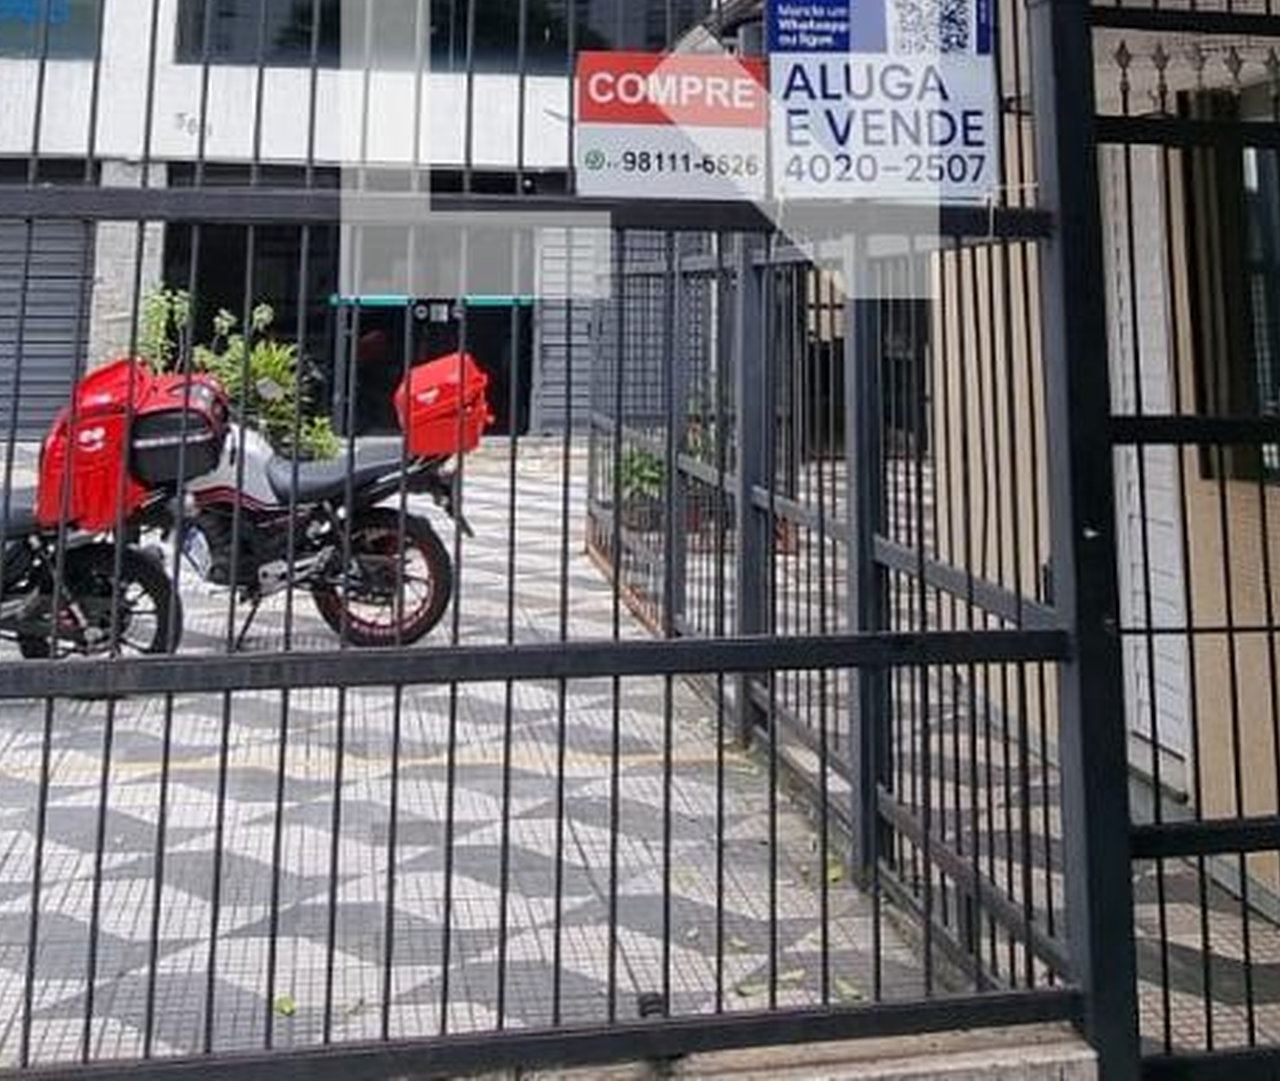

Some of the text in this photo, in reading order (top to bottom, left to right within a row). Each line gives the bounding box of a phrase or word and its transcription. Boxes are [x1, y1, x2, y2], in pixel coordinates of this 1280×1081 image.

[587, 72, 756, 109] COMPRE
[782, 63, 949, 102] ALUGA
[786, 109, 985, 148] E VENDE
[784, 153, 986, 183] 4020-2507
